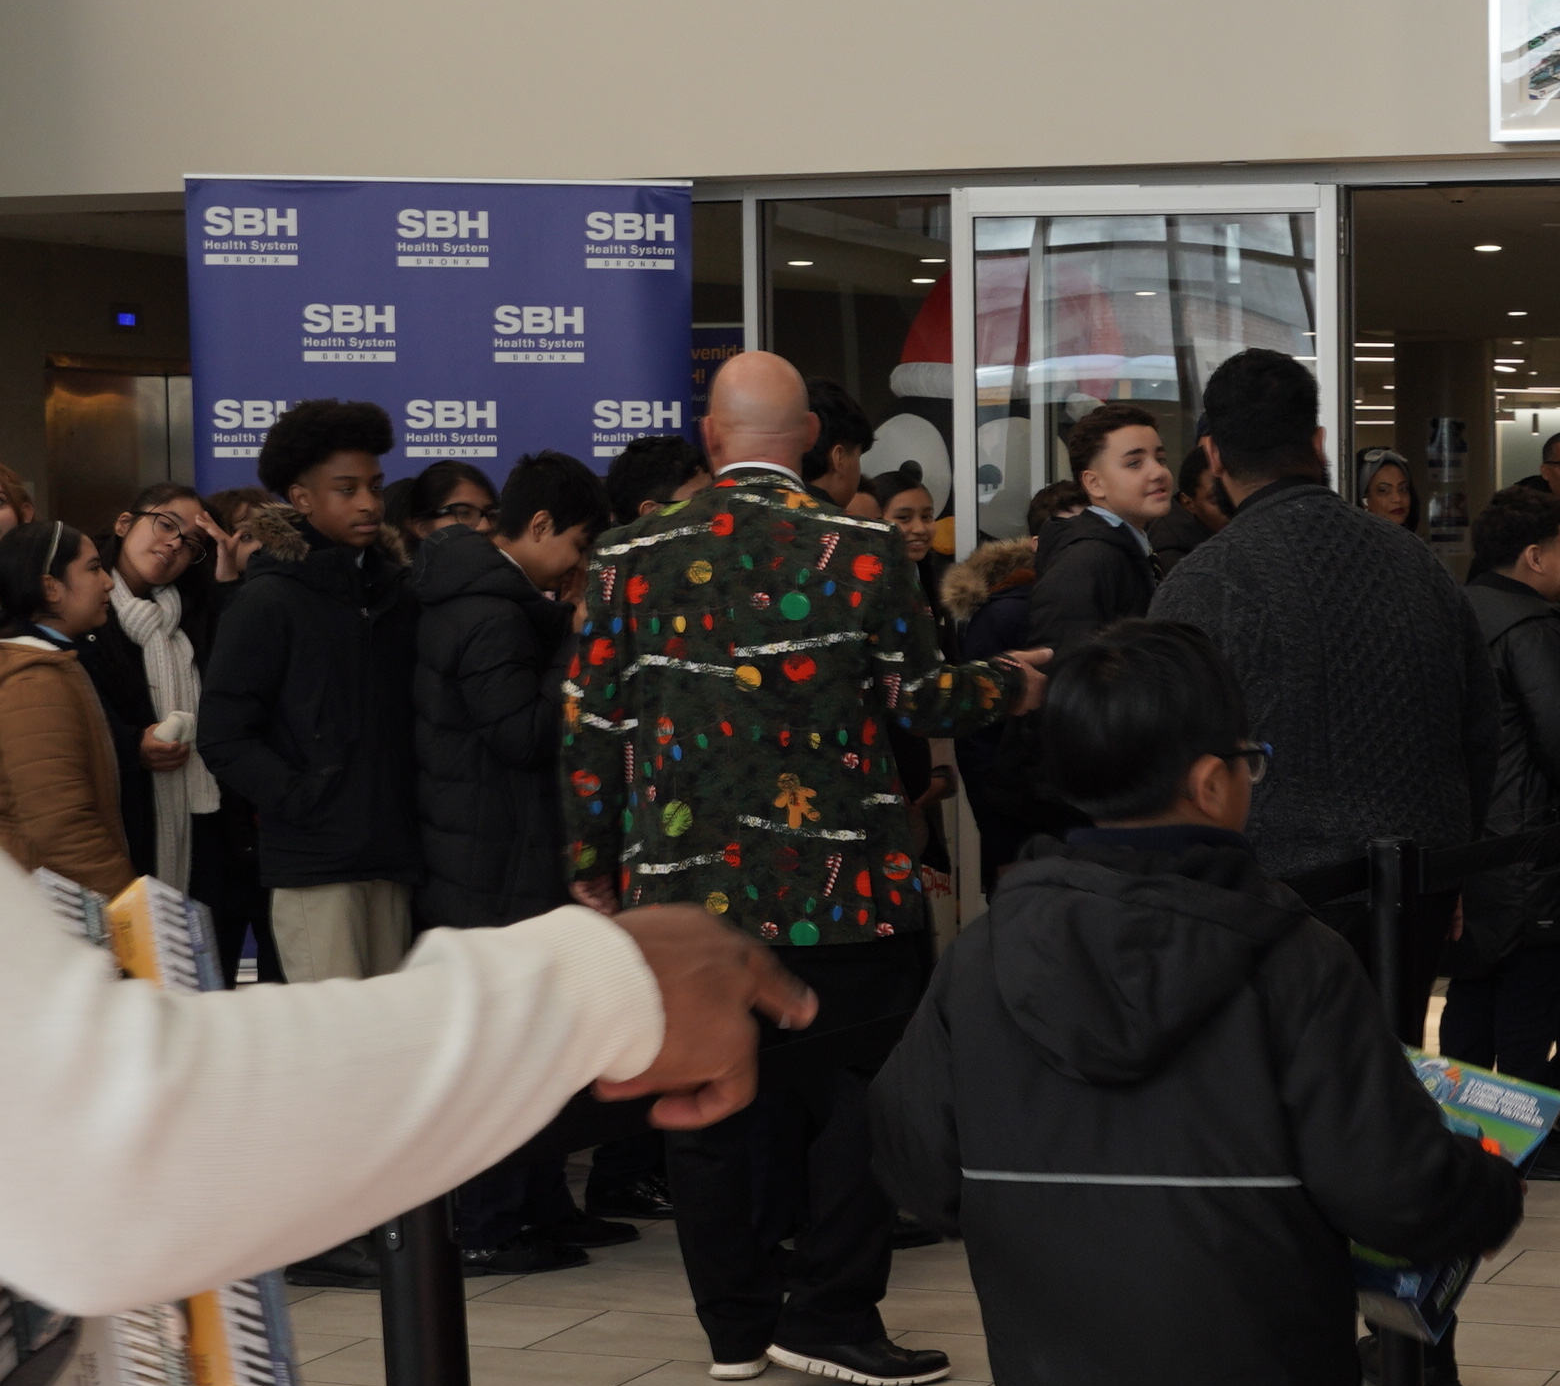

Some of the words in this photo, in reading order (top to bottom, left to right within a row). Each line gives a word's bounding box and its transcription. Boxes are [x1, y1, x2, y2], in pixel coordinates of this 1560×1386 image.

[204, 206, 298, 237] SBH
[397, 209, 489, 239] SBH
[585, 212, 675, 241] SBH
[204, 239, 244, 251] Health
[248, 240, 298, 253] System
[397, 242, 437, 254] Health
[440, 243, 489, 256] System
[585, 244, 624, 256] Health
[627, 245, 675, 258] System
[223, 256, 281, 264] BRONX
[416, 258, 472, 266] BRONX
[604, 260, 658, 268] BRONX
[303, 304, 396, 334] SBH
[494, 305, 584, 335] SBH
[303, 336, 344, 348] Health
[348, 337, 396, 350] System
[494, 338, 534, 349] Health
[538, 338, 584, 351] System
[322, 353, 378, 361] BRONX
[513, 354, 567, 362] BRONX
[406, 400, 497, 429] SBH
[593, 401, 682, 429] SBH
[213, 432, 256, 444] Health
[406, 432, 446, 444] Health
[450, 433, 497, 446] System
[593, 432, 633, 443] Health
[424, 448, 480, 456] BRONX
